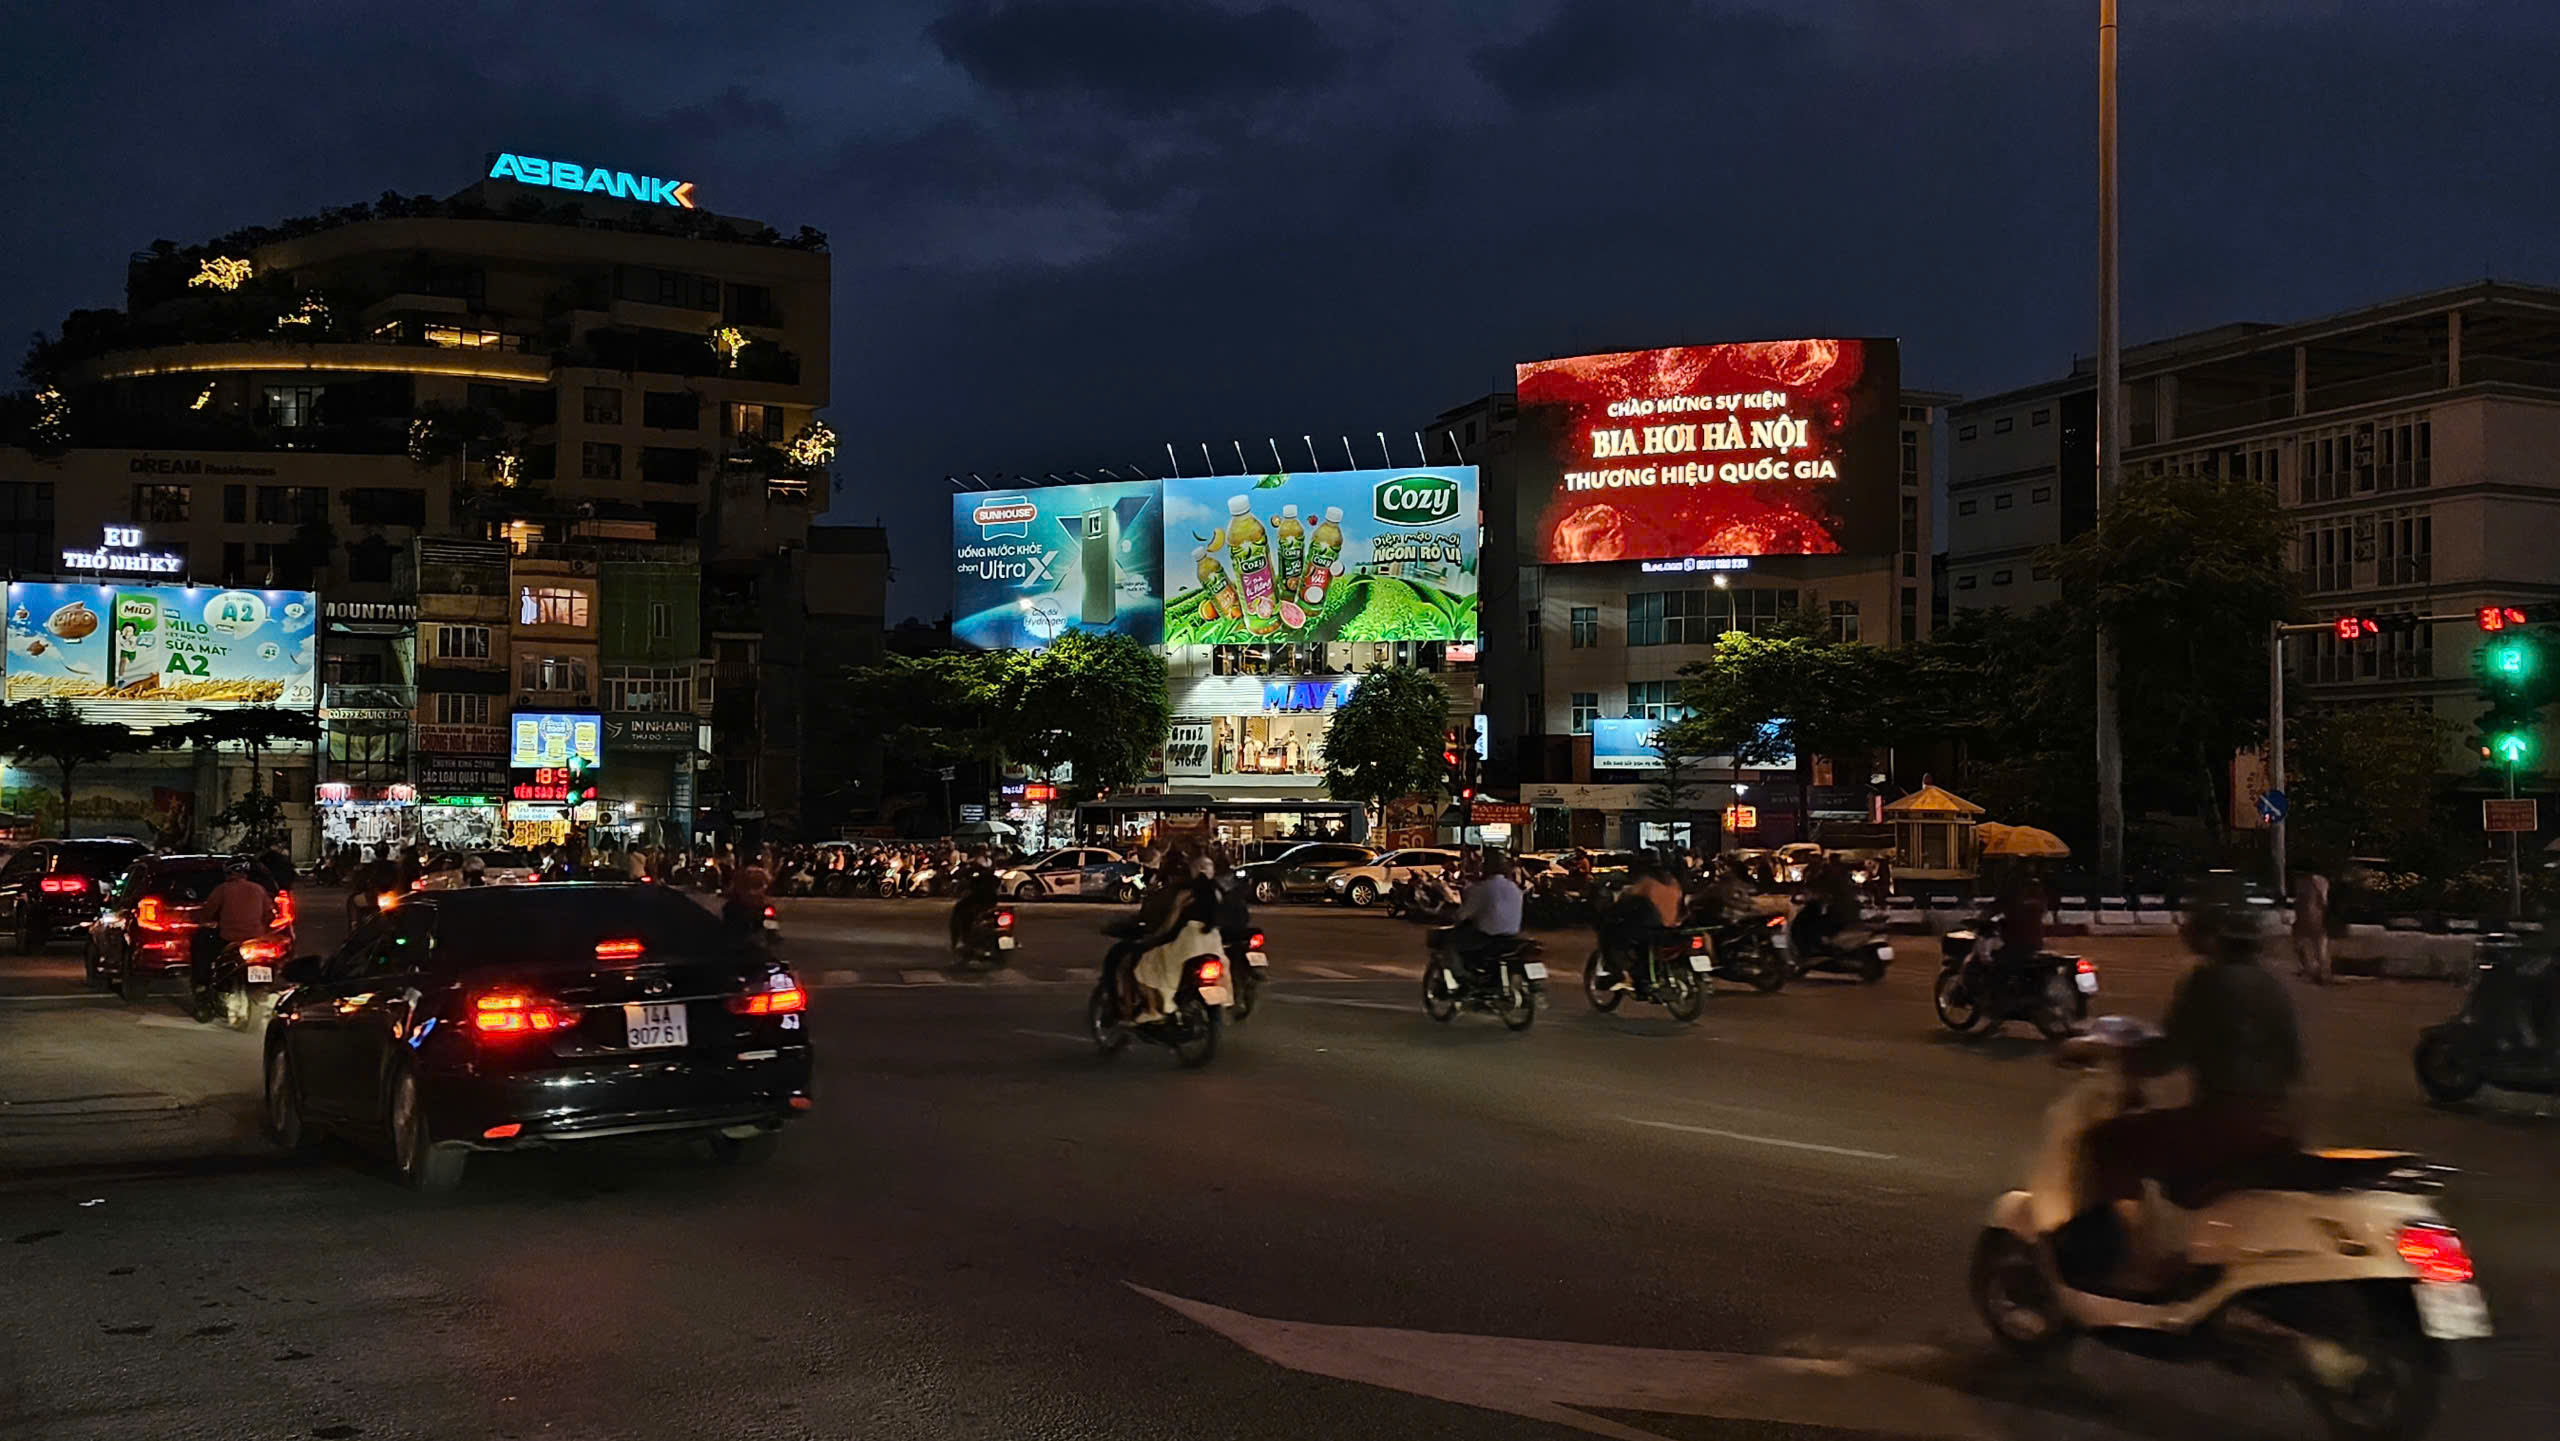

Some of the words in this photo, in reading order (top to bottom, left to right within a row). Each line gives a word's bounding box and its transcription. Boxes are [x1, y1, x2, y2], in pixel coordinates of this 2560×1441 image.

[489, 153, 681, 207] ABBANK
[1607, 398, 1655, 417] CHÀO
[1657, 395, 1712, 413] MỪNG
[1715, 393, 1742, 411] SỰ
[1744, 390, 1786, 410] KIỆN
[1591, 428, 1639, 458] BIA
[1642, 423, 1697, 454] HƠI
[1701, 414, 1747, 451] HÀ
[1750, 413, 1808, 454] NỘI
[129, 458, 202, 474] DREAM
[1564, 467, 1656, 491] THƯƠNG
[1661, 462, 1714, 486] HIỆU
[1719, 457, 1789, 483] QUỐC
[1794, 460, 1837, 480] GIA
[1383, 485, 1450, 515] Cozy
[979, 508, 1032, 521] SUNHOUSE
[104, 527, 143, 547] EU
[63, 545, 109, 569] THỔ
[958, 544, 986, 559] UỐNG
[987, 543, 1015, 557] NƯỚC
[1016, 541, 1043, 555] KHỎE
[1373, 546, 1416, 562] NGON
[957, 563, 979, 574] chọn
[124, 605, 152, 616] MILO
[221, 602, 255, 622] A2
[325, 602, 417, 619] MOUNTAIN
[165, 619, 209, 635] MILO
[166, 639, 195, 653] SỮA
[165, 652, 211, 677] A2
[1263, 682, 1333, 710] MAY
[631, 720, 644, 732] IN
[645, 720, 693, 732] NHANH
[643, 1006, 672, 1025] 14A
[629, 1025, 685, 1046] 307.61
